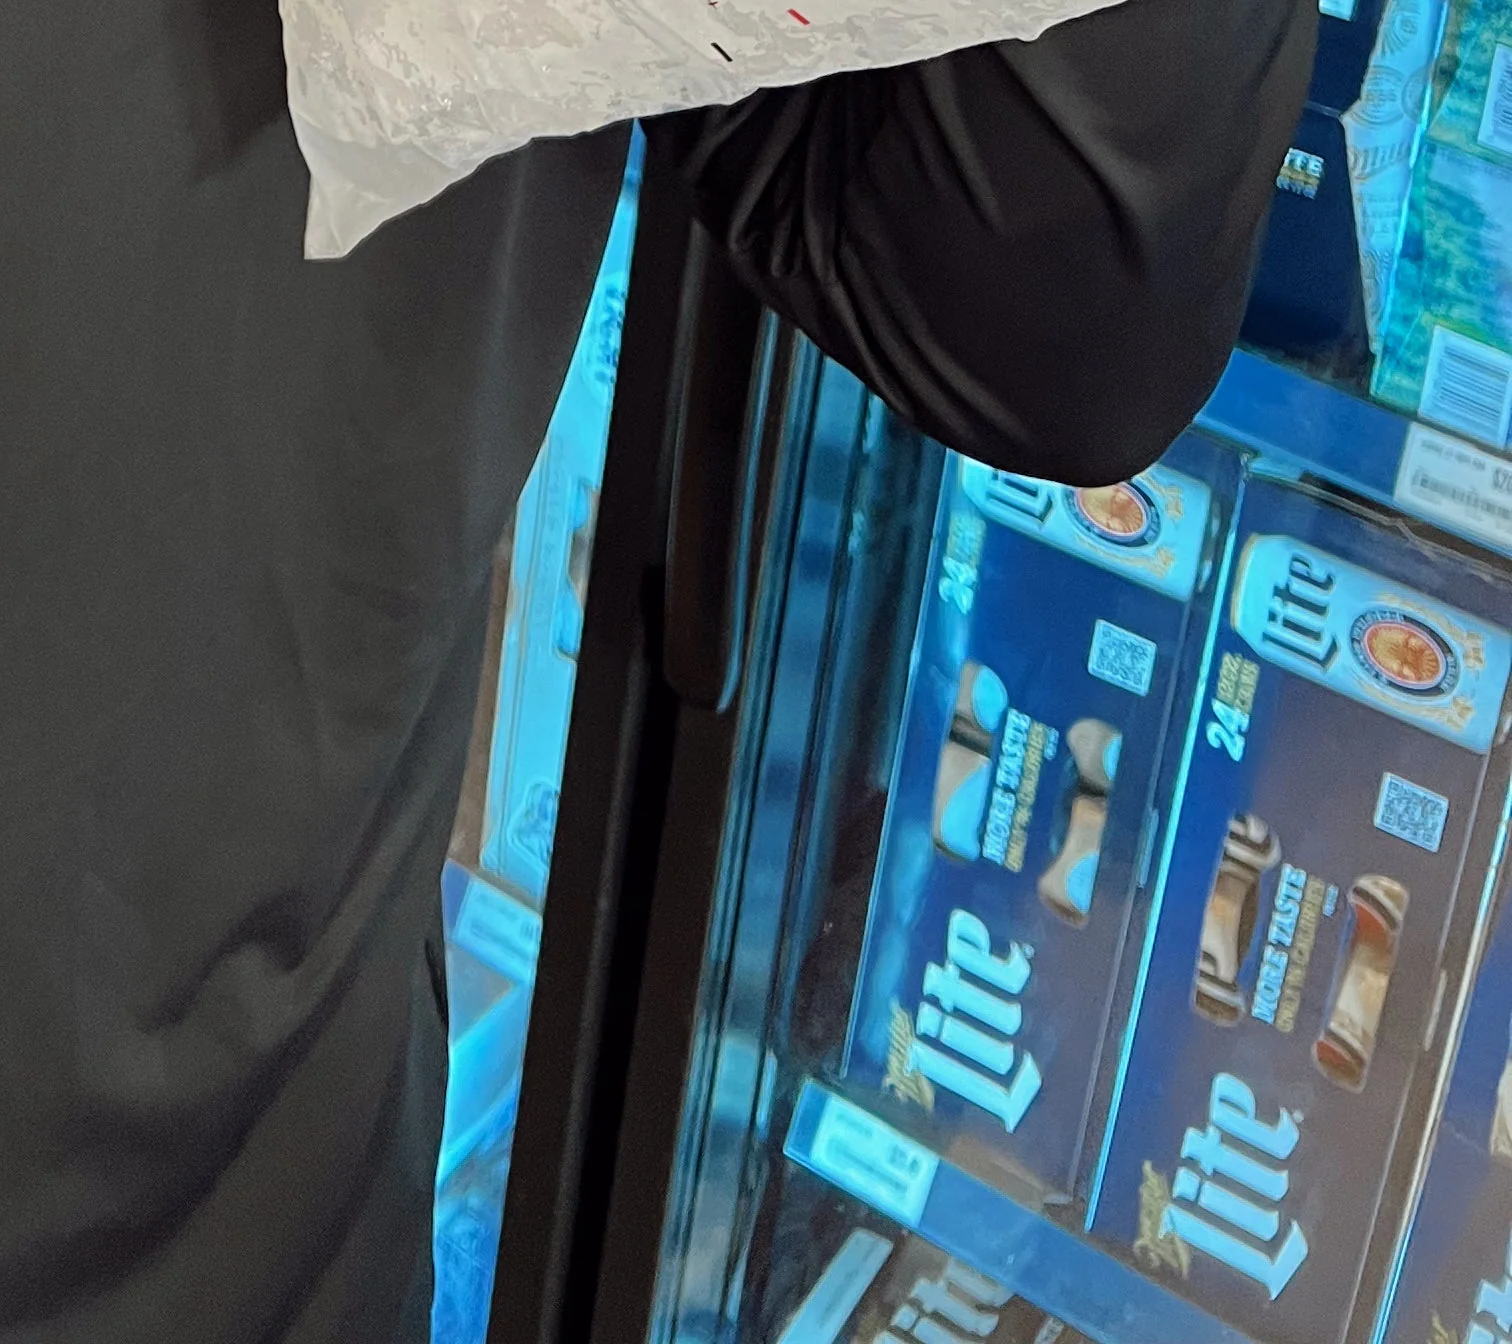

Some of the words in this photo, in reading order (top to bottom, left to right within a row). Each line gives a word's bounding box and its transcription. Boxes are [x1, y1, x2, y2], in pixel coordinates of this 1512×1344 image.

[1259, 552, 1340, 673] Lite
[1205, 698, 1251, 762] 24
[1267, 862, 1307, 948] TASTE
[903, 908, 1043, 1134] Lite
[1250, 944, 1289, 1025] MORE
[1157, 1072, 1309, 1301] Lite
